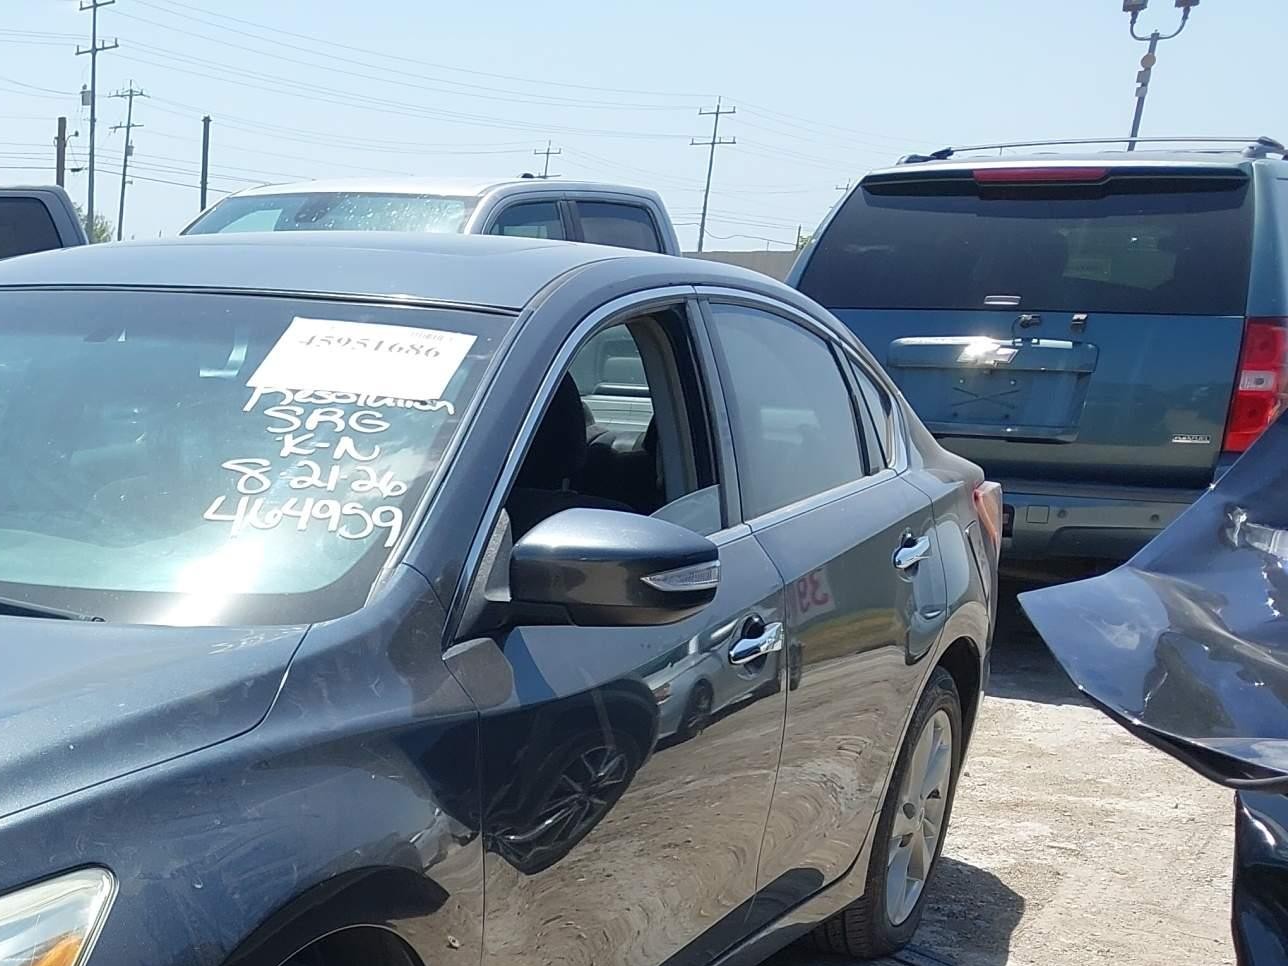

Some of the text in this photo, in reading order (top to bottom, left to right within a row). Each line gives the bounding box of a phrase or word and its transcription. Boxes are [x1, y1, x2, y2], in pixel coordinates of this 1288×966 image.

[299, 335, 440, 360] 45951686
[263, 405, 390, 433] SRG
[203, 496, 404, 548] 464959
